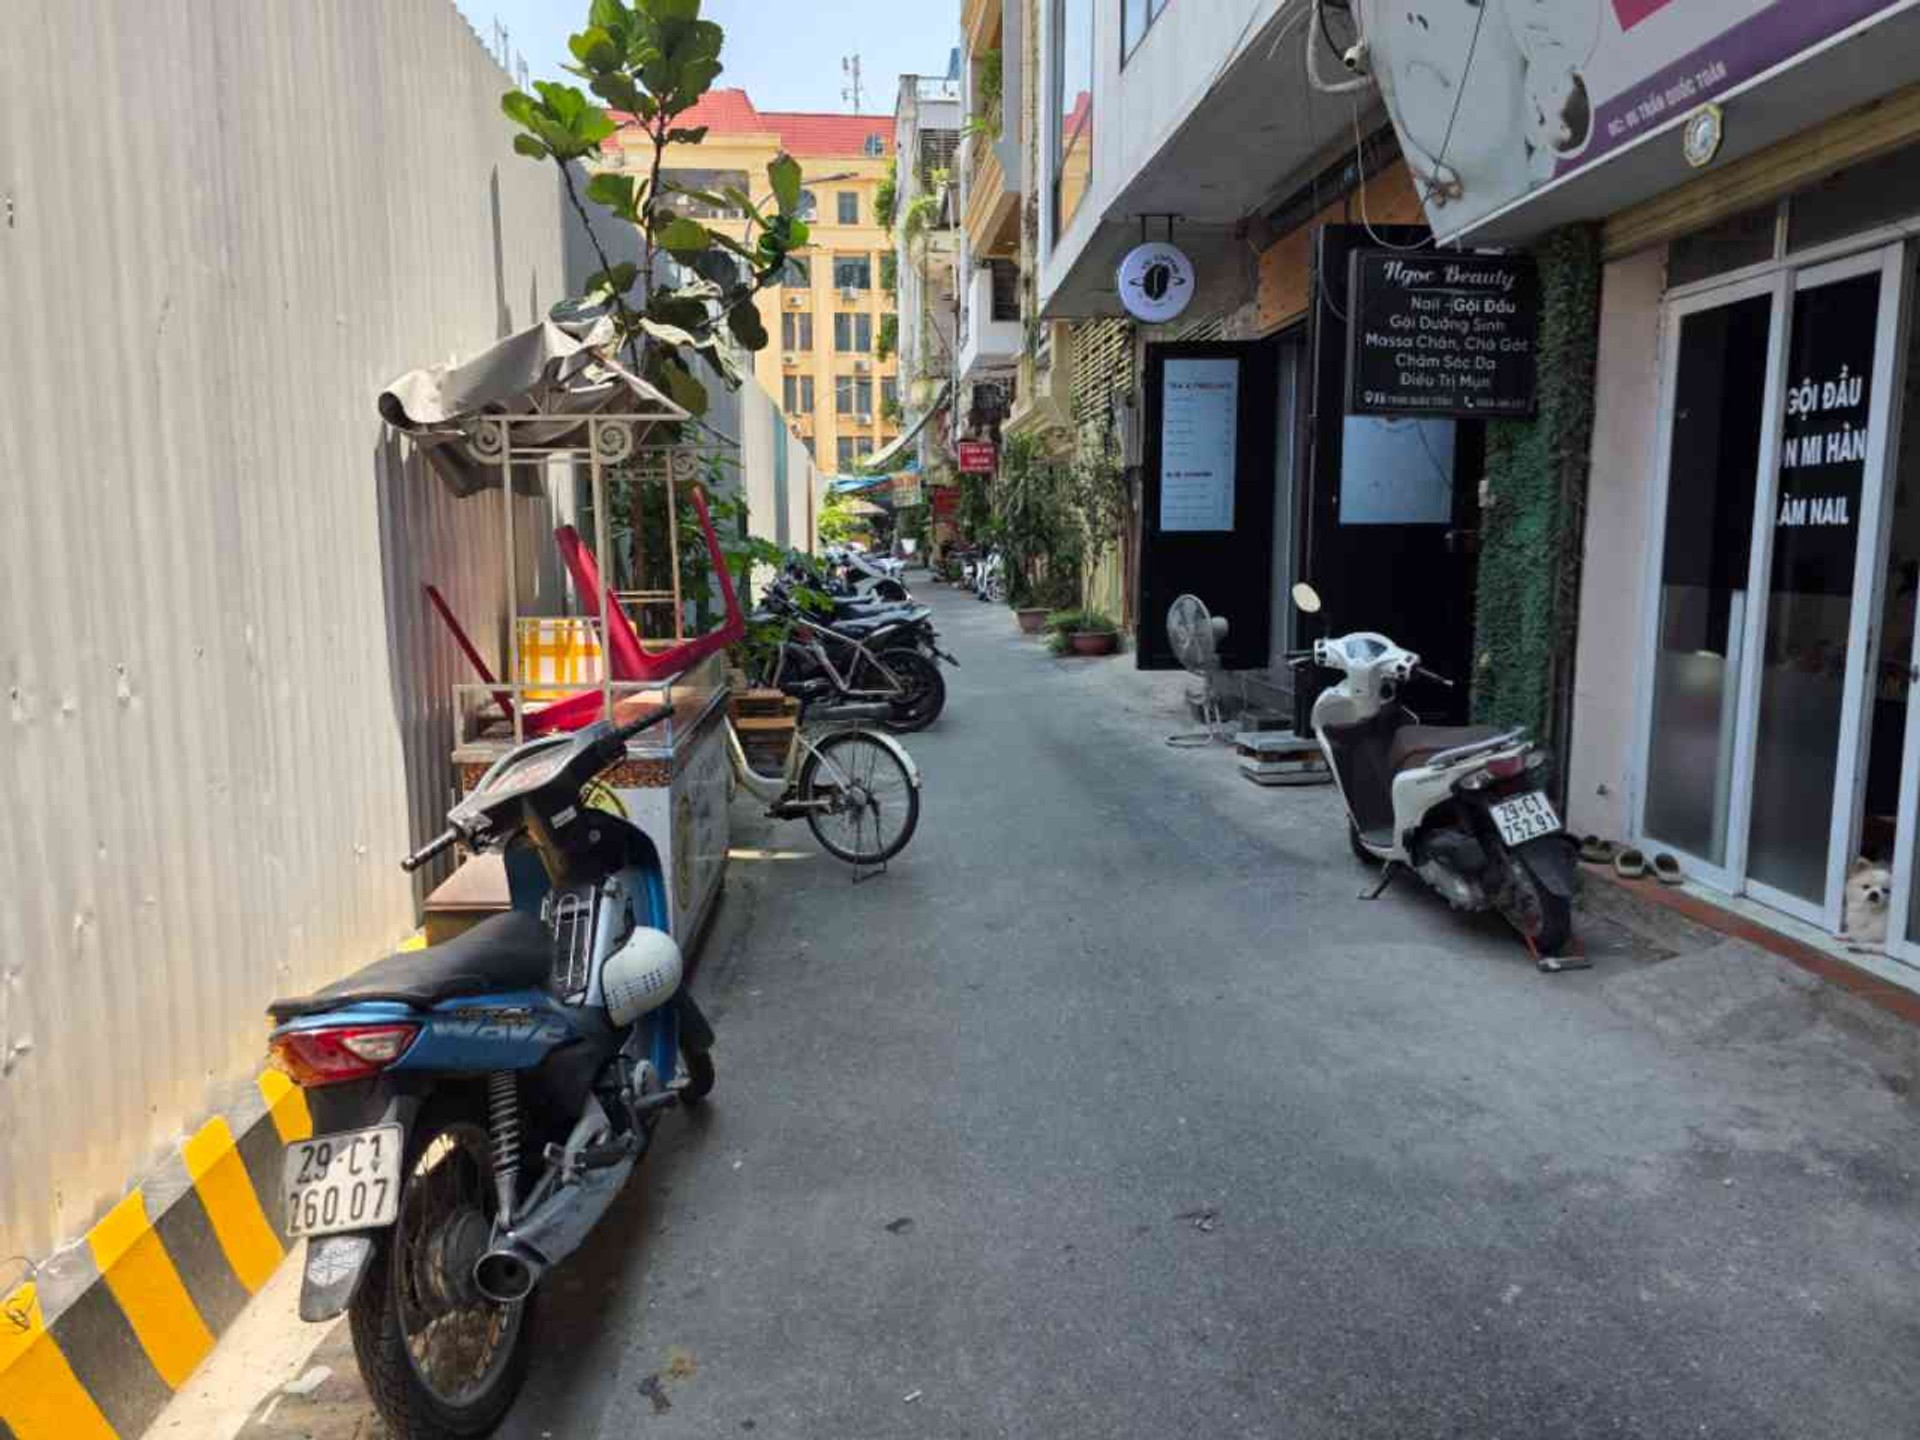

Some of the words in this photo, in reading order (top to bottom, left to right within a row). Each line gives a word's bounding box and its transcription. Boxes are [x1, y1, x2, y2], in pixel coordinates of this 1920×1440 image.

[1443, 263, 1516, 292] Beauty
[1410, 296, 1440, 311] Nail
[1453, 297, 1480, 316] Gội
[1366, 332, 1413, 348] Massa
[1475, 355, 1496, 370] Da
[1800, 434, 1823, 467] MI
[1825, 421, 1867, 464] HÀN
[1778, 492, 1806, 526] ÀM
[1809, 496, 1850, 525] NAIL
[296, 1133, 384, 1184] 29-C1
[289, 1178, 389, 1233] 260.07
